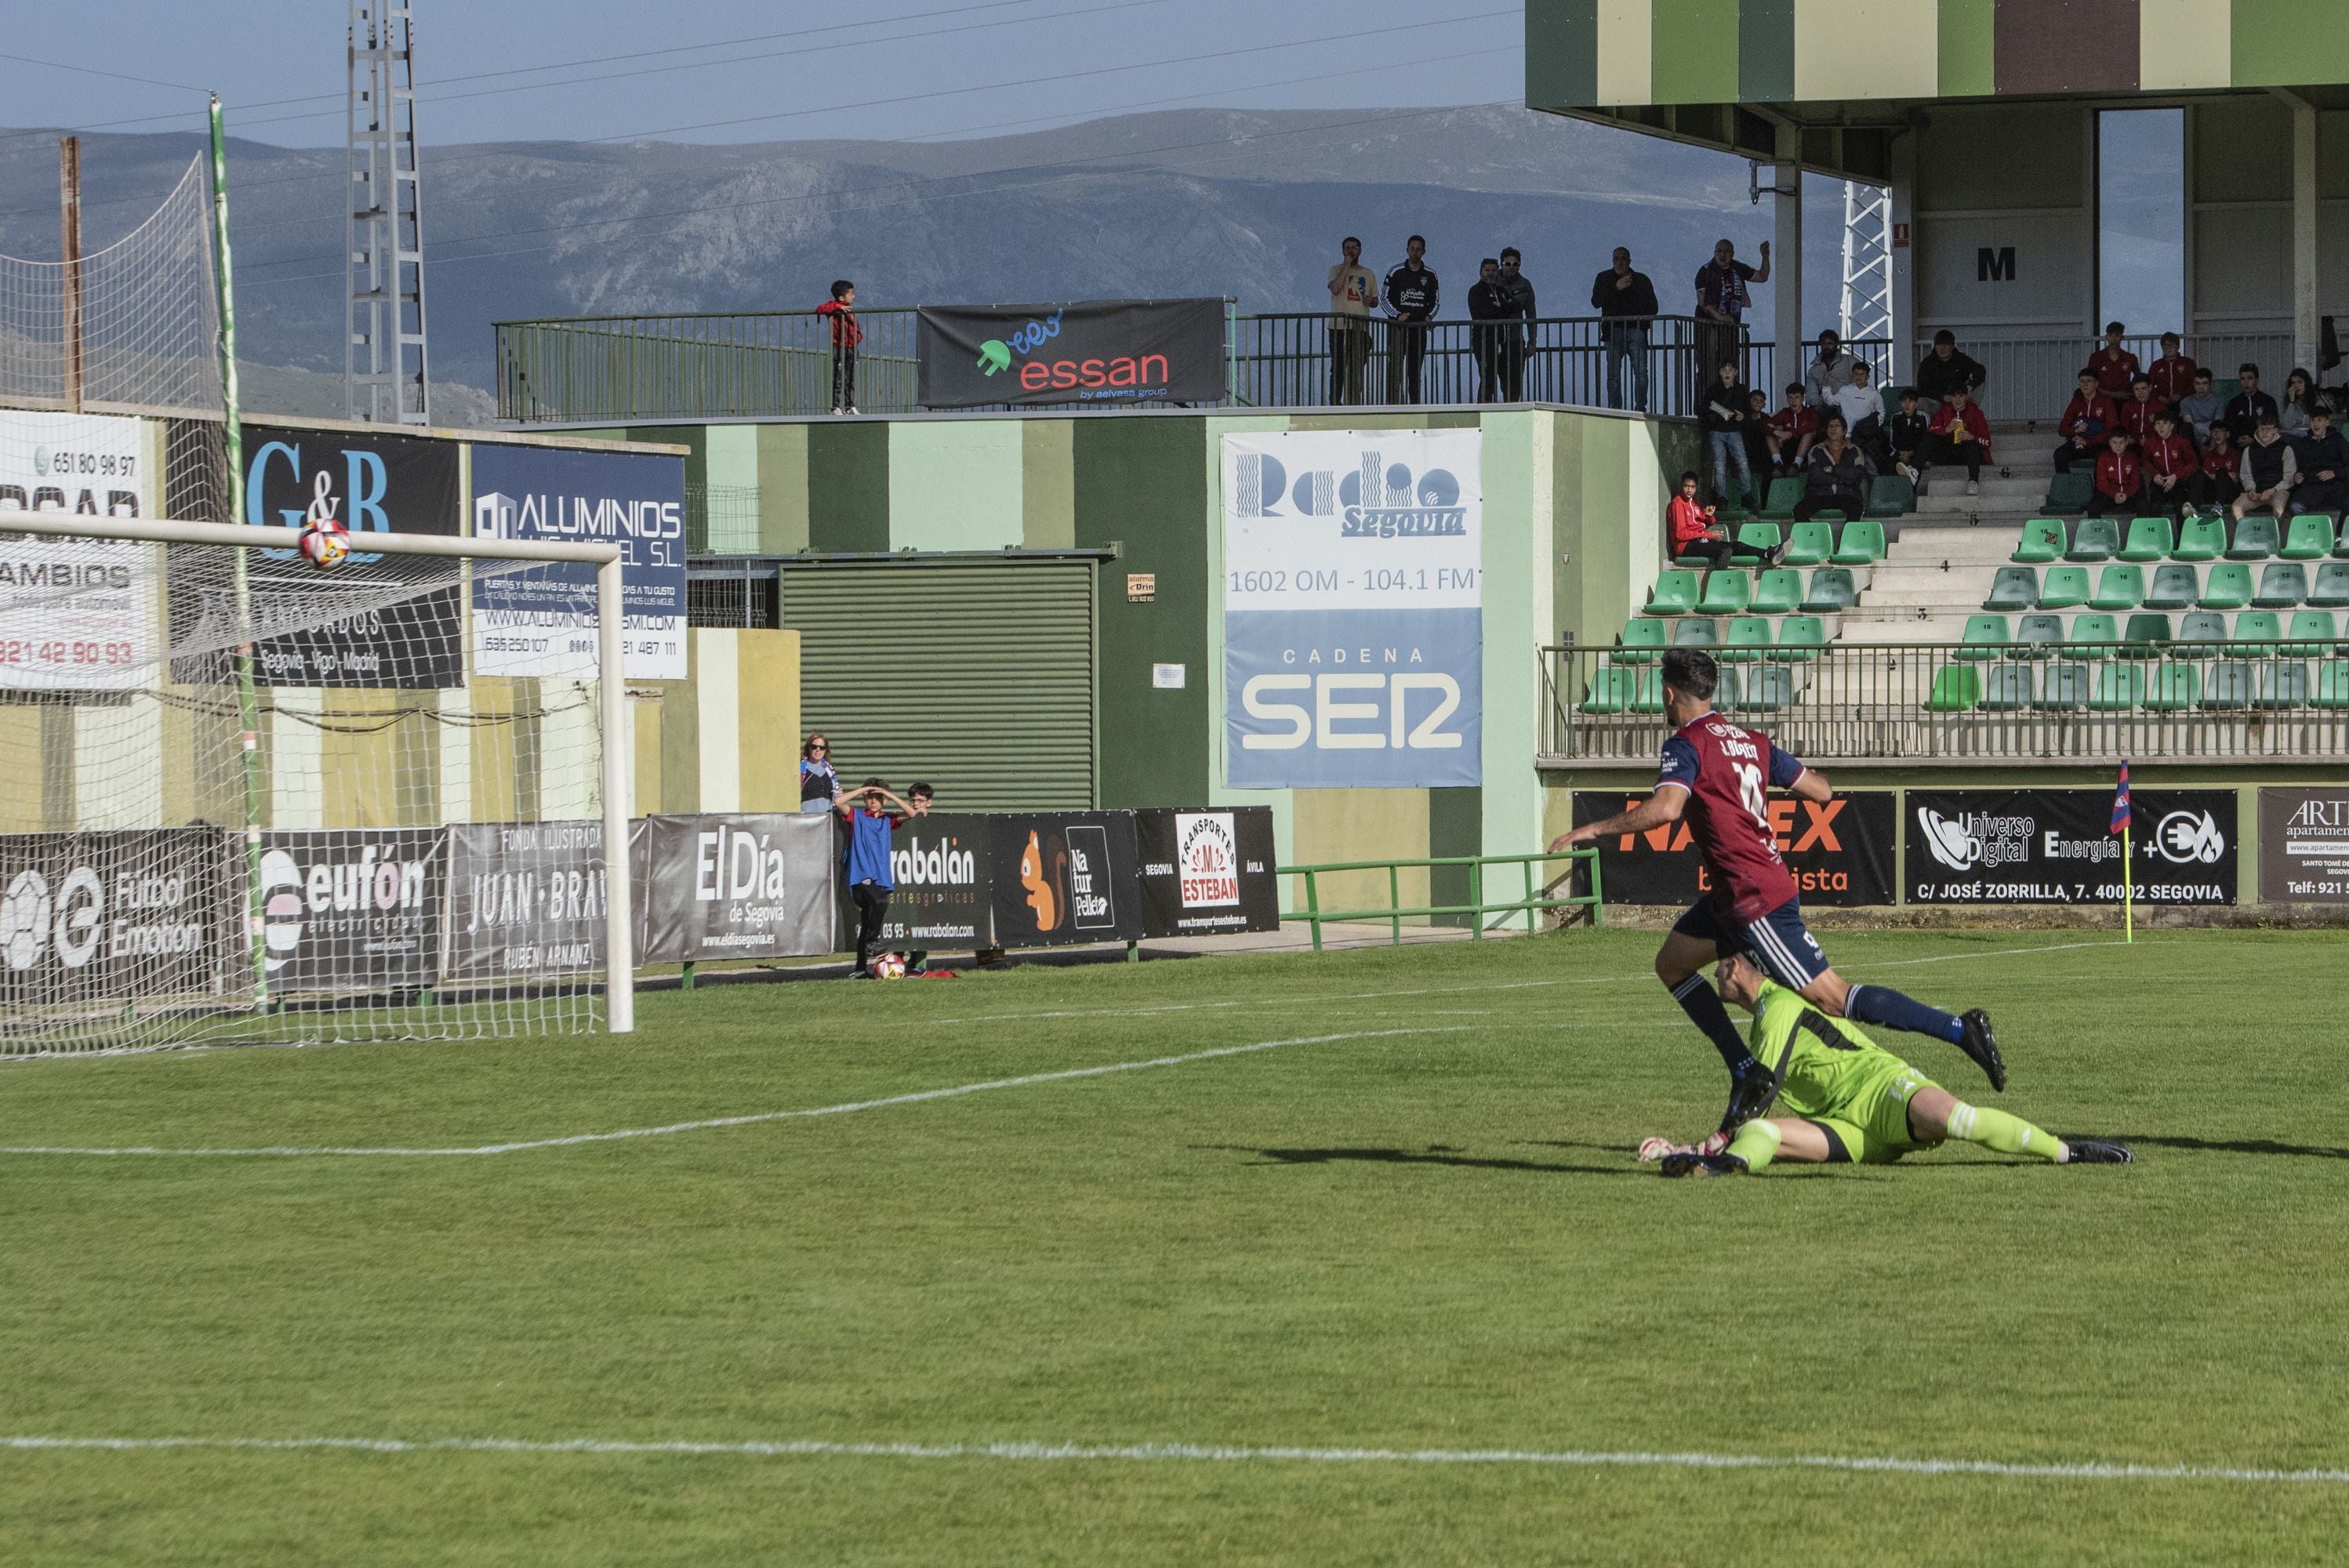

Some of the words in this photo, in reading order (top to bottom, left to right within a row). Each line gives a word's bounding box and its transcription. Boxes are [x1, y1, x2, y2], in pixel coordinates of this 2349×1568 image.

[1977, 247, 2016, 281] M
[1020, 354, 1168, 390] essan
[1080, 390, 1093, 399] by
[1138, 388, 1167, 397] group
[54, 452, 75, 473] 651
[79, 453, 96, 474] 80
[100, 455, 116, 476] 98
[120, 456, 136, 476] 97
[1236, 451, 1461, 517] Radio
[517, 494, 681, 539] ALUMINIOS
[1341, 506, 1468, 539] Segovia
[1230, 570, 1287, 593] 1602
[1295, 569, 1339, 591] OM
[1363, 568, 1429, 591] 104.1
[1437, 568, 1475, 590] FM
[39, 641, 65, 663] 42
[74, 641, 99, 664] 90
[106, 642, 132, 664] 93
[638, 641, 660, 655] 487
[1283, 648, 1423, 665] CADENA
[262, 649, 304, 674] Segovia
[343, 651, 379, 671] Madrid
[1242, 672, 1463, 750] SER
[1959, 811, 2035, 837] Universo
[503, 829, 538, 851] FONDA
[544, 827, 602, 850] ILUSTRADA
[1181, 818, 1235, 866] TRANSPORTES
[2045, 831, 2120, 863] Energía
[695, 825, 727, 900] El
[730, 831, 784, 900] Día
[1071, 849, 1088, 872] Na
[1965, 837, 2029, 868] Digital
[307, 844, 425, 913] eufón
[1145, 863, 1174, 876] SEGOVIA
[1247, 859, 1265, 873] ÁVILA
[1073, 871, 1092, 893] tur
[1182, 877, 1238, 902] ESTEBAN
[1918, 884, 1935, 899] C/
[1940, 881, 1982, 899] JOSÉ
[1986, 884, 2071, 901] ZORRILLA,
[2075, 884, 2091, 898] 7.
[2150, 884, 2224, 899] SEGOVIA
[2287, 881, 2316, 894] Telf:
[2318, 882, 2341, 894] 921
[467, 872, 534, 935] JUAN
[729, 900, 742, 923] de
[745, 900, 784, 928] Segovia
[883, 923, 893, 938] 03
[895, 923, 904, 938] 93
[1178, 914, 1247, 928] www.transportesesteban.es
[503, 940, 540, 970] RUBÉN
[546, 942, 590, 967] ARNANZ
